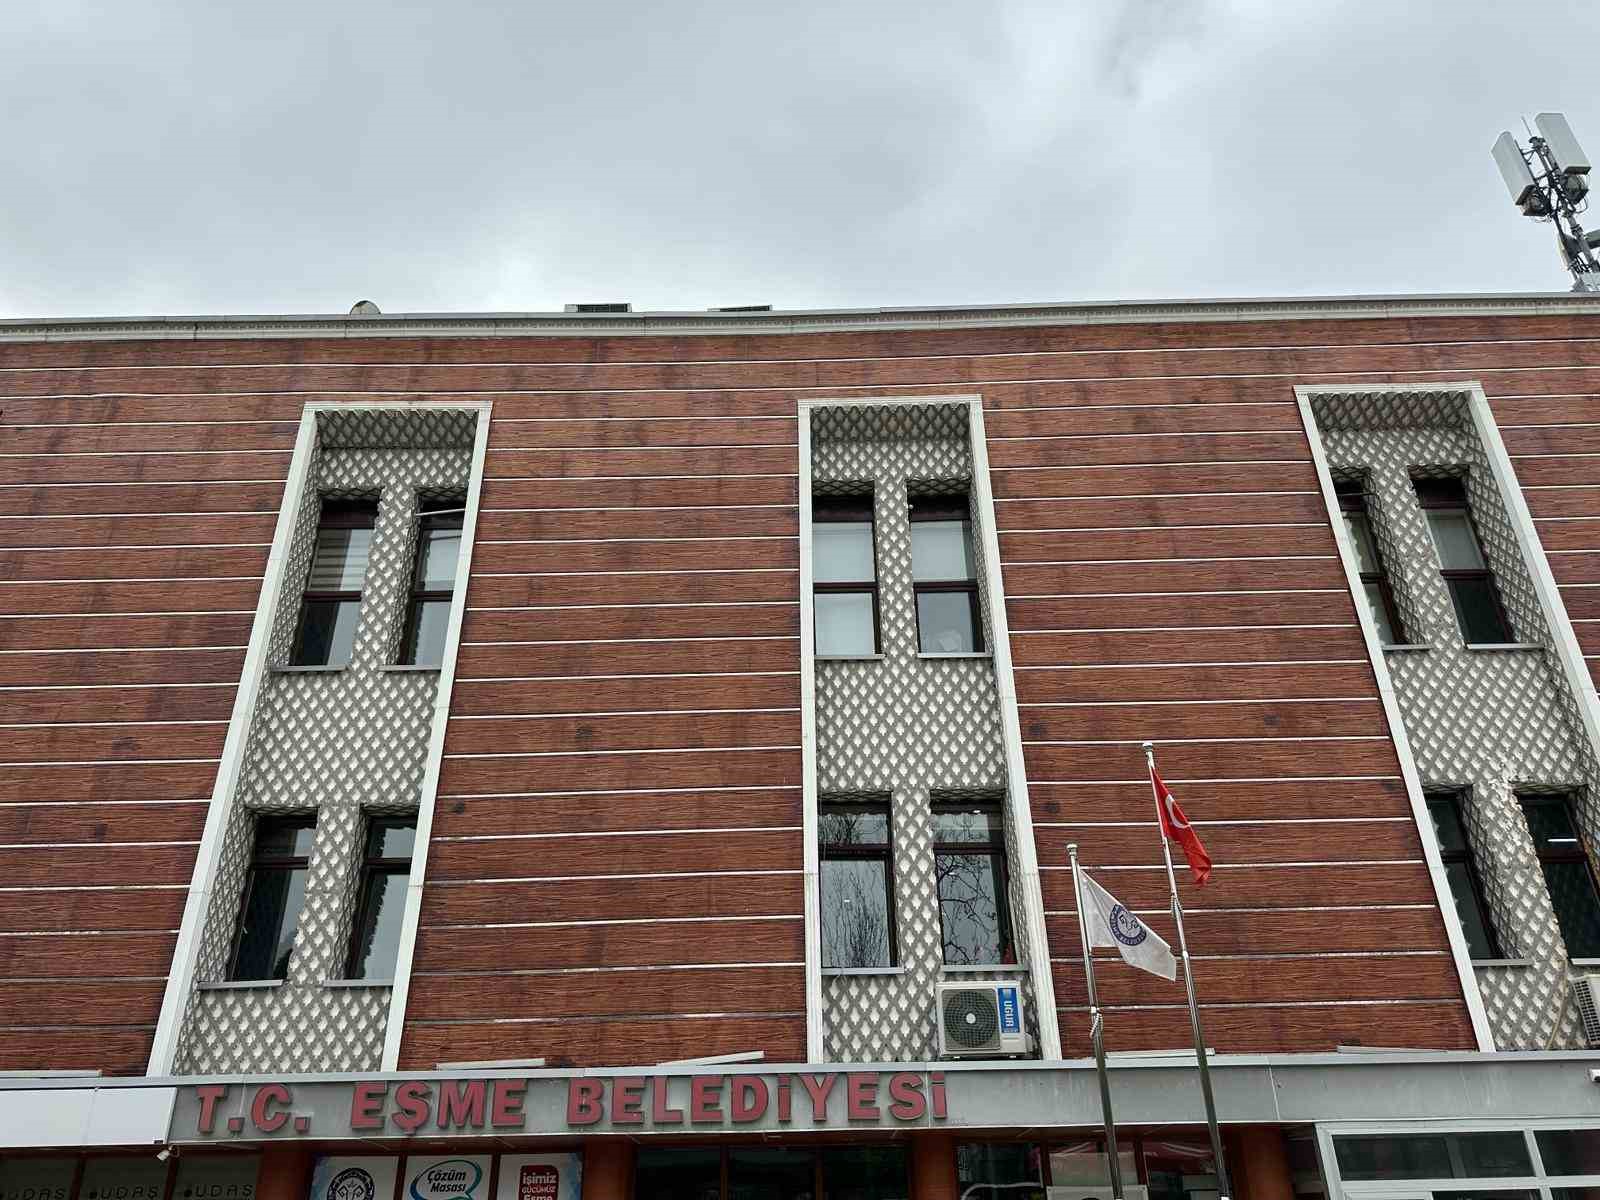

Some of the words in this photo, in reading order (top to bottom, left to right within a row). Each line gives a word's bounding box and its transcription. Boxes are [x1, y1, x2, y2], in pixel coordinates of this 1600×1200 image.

[196, 1083, 311, 1134] T.C.
[350, 1079, 528, 1137] EŞME
[427, 1170, 466, 1185] Çözüm
[430, 1182, 467, 1193] Masası
